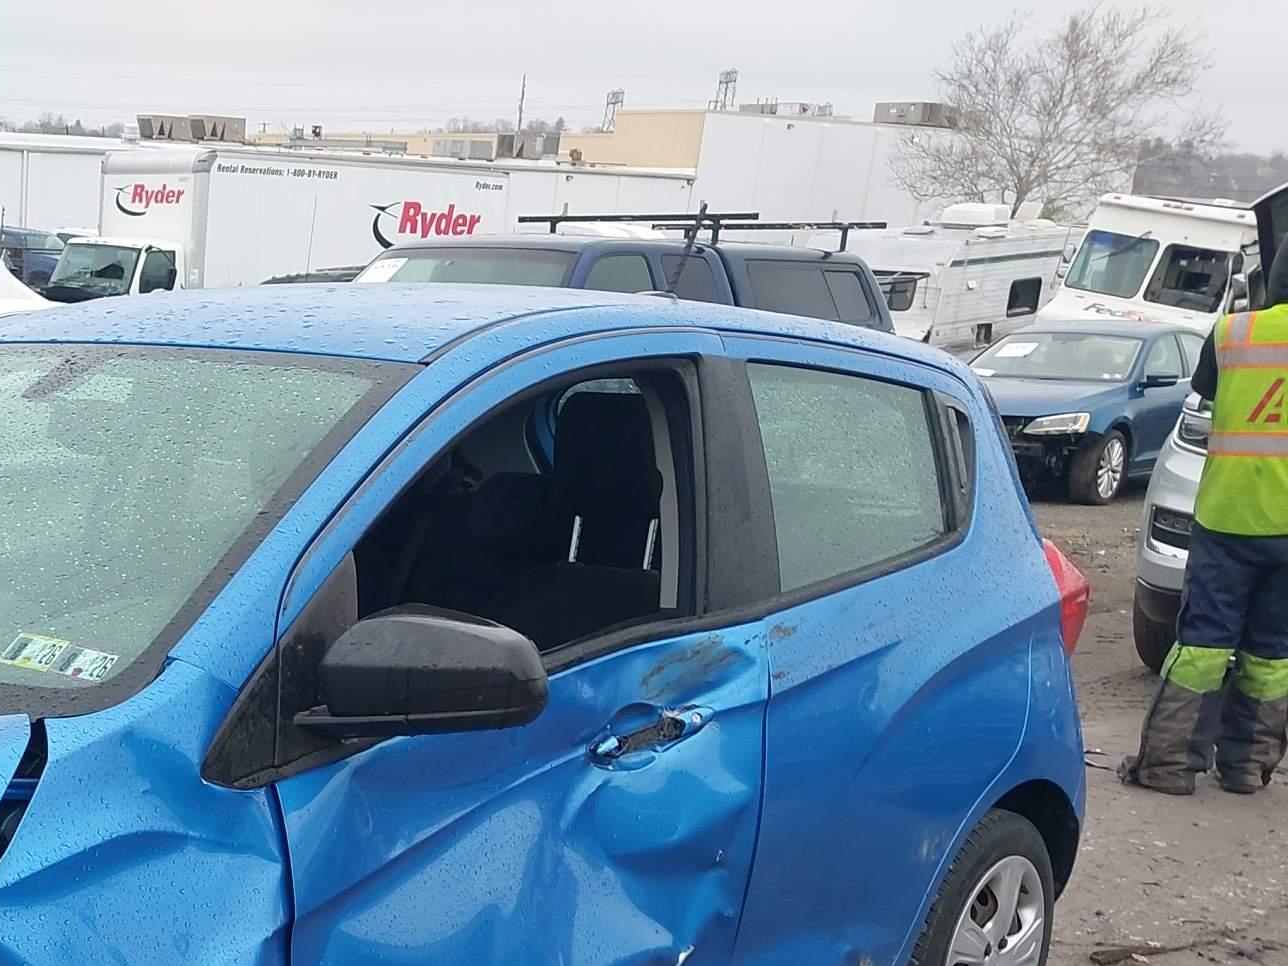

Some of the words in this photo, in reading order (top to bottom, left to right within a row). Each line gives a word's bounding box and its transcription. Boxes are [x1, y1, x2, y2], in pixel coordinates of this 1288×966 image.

[216, 163, 239, 174] Rental
[239, 165, 285, 177] Reservations:
[286, 169, 339, 180] 1-800-BY-RYDER
[130, 183, 185, 209] Ryder
[475, 181, 504, 191] Ryder.com
[398, 201, 482, 238] Ryder
